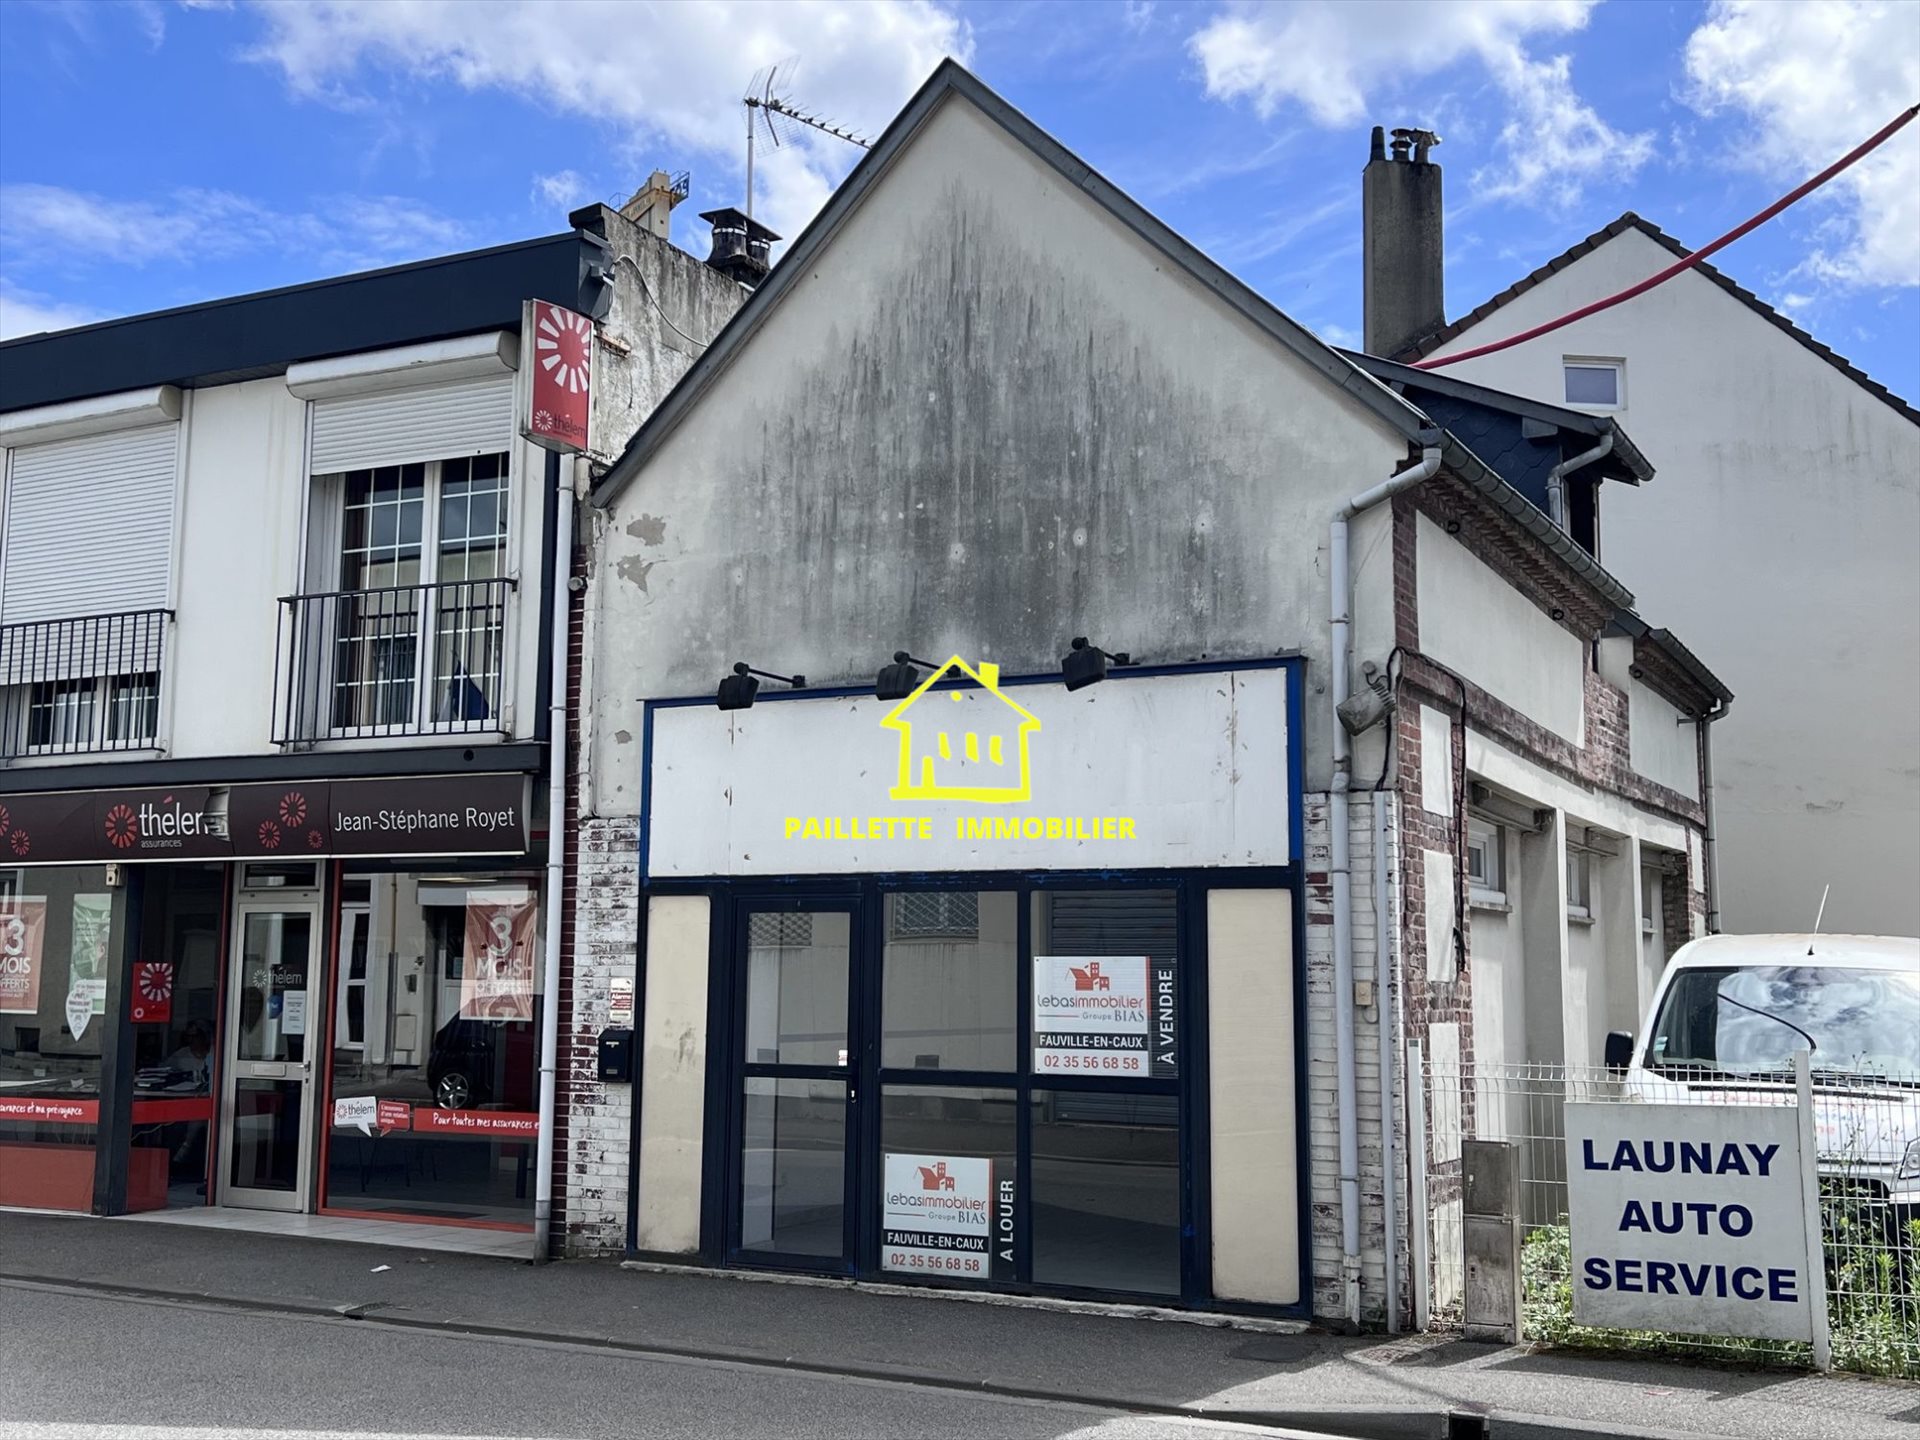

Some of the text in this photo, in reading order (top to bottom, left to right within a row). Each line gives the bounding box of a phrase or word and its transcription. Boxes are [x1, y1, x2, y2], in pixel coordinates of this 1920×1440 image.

[335, 806, 515, 834] Jean-Stéphane Royet
[140, 839, 183, 848] assurances
[5, 918, 25, 955] 3
[1037, 994, 1145, 1009] lebasimmobilier
[1158, 970, 1174, 1046] VENDRE
[1082, 1010, 1145, 1022] Groupe BIAS
[1039, 1035, 1143, 1048] FAUVILLE-EN-CAUX
[1044, 1055, 1139, 1070] 02 35 56 68 58
[433, 1112, 450, 1125] Pour
[452, 1113, 475, 1127] toutes
[477, 1118, 491, 1128] mes
[493, 1119, 532, 1130] assurances
[1582, 1139, 1780, 1177] LAUNAY
[886, 1192, 986, 1211] lebasimmobilier
[928, 1211, 986, 1225] Groupe BIAS
[1000, 1180, 1014, 1243] LOUER
[1618, 1200, 1753, 1237] AUTO
[887, 1232, 984, 1250] FAUVILLE-EN-CAUX
[891, 1253, 980, 1271] 02 35 56 68 58
[1583, 1257, 1799, 1303] SERVICE
